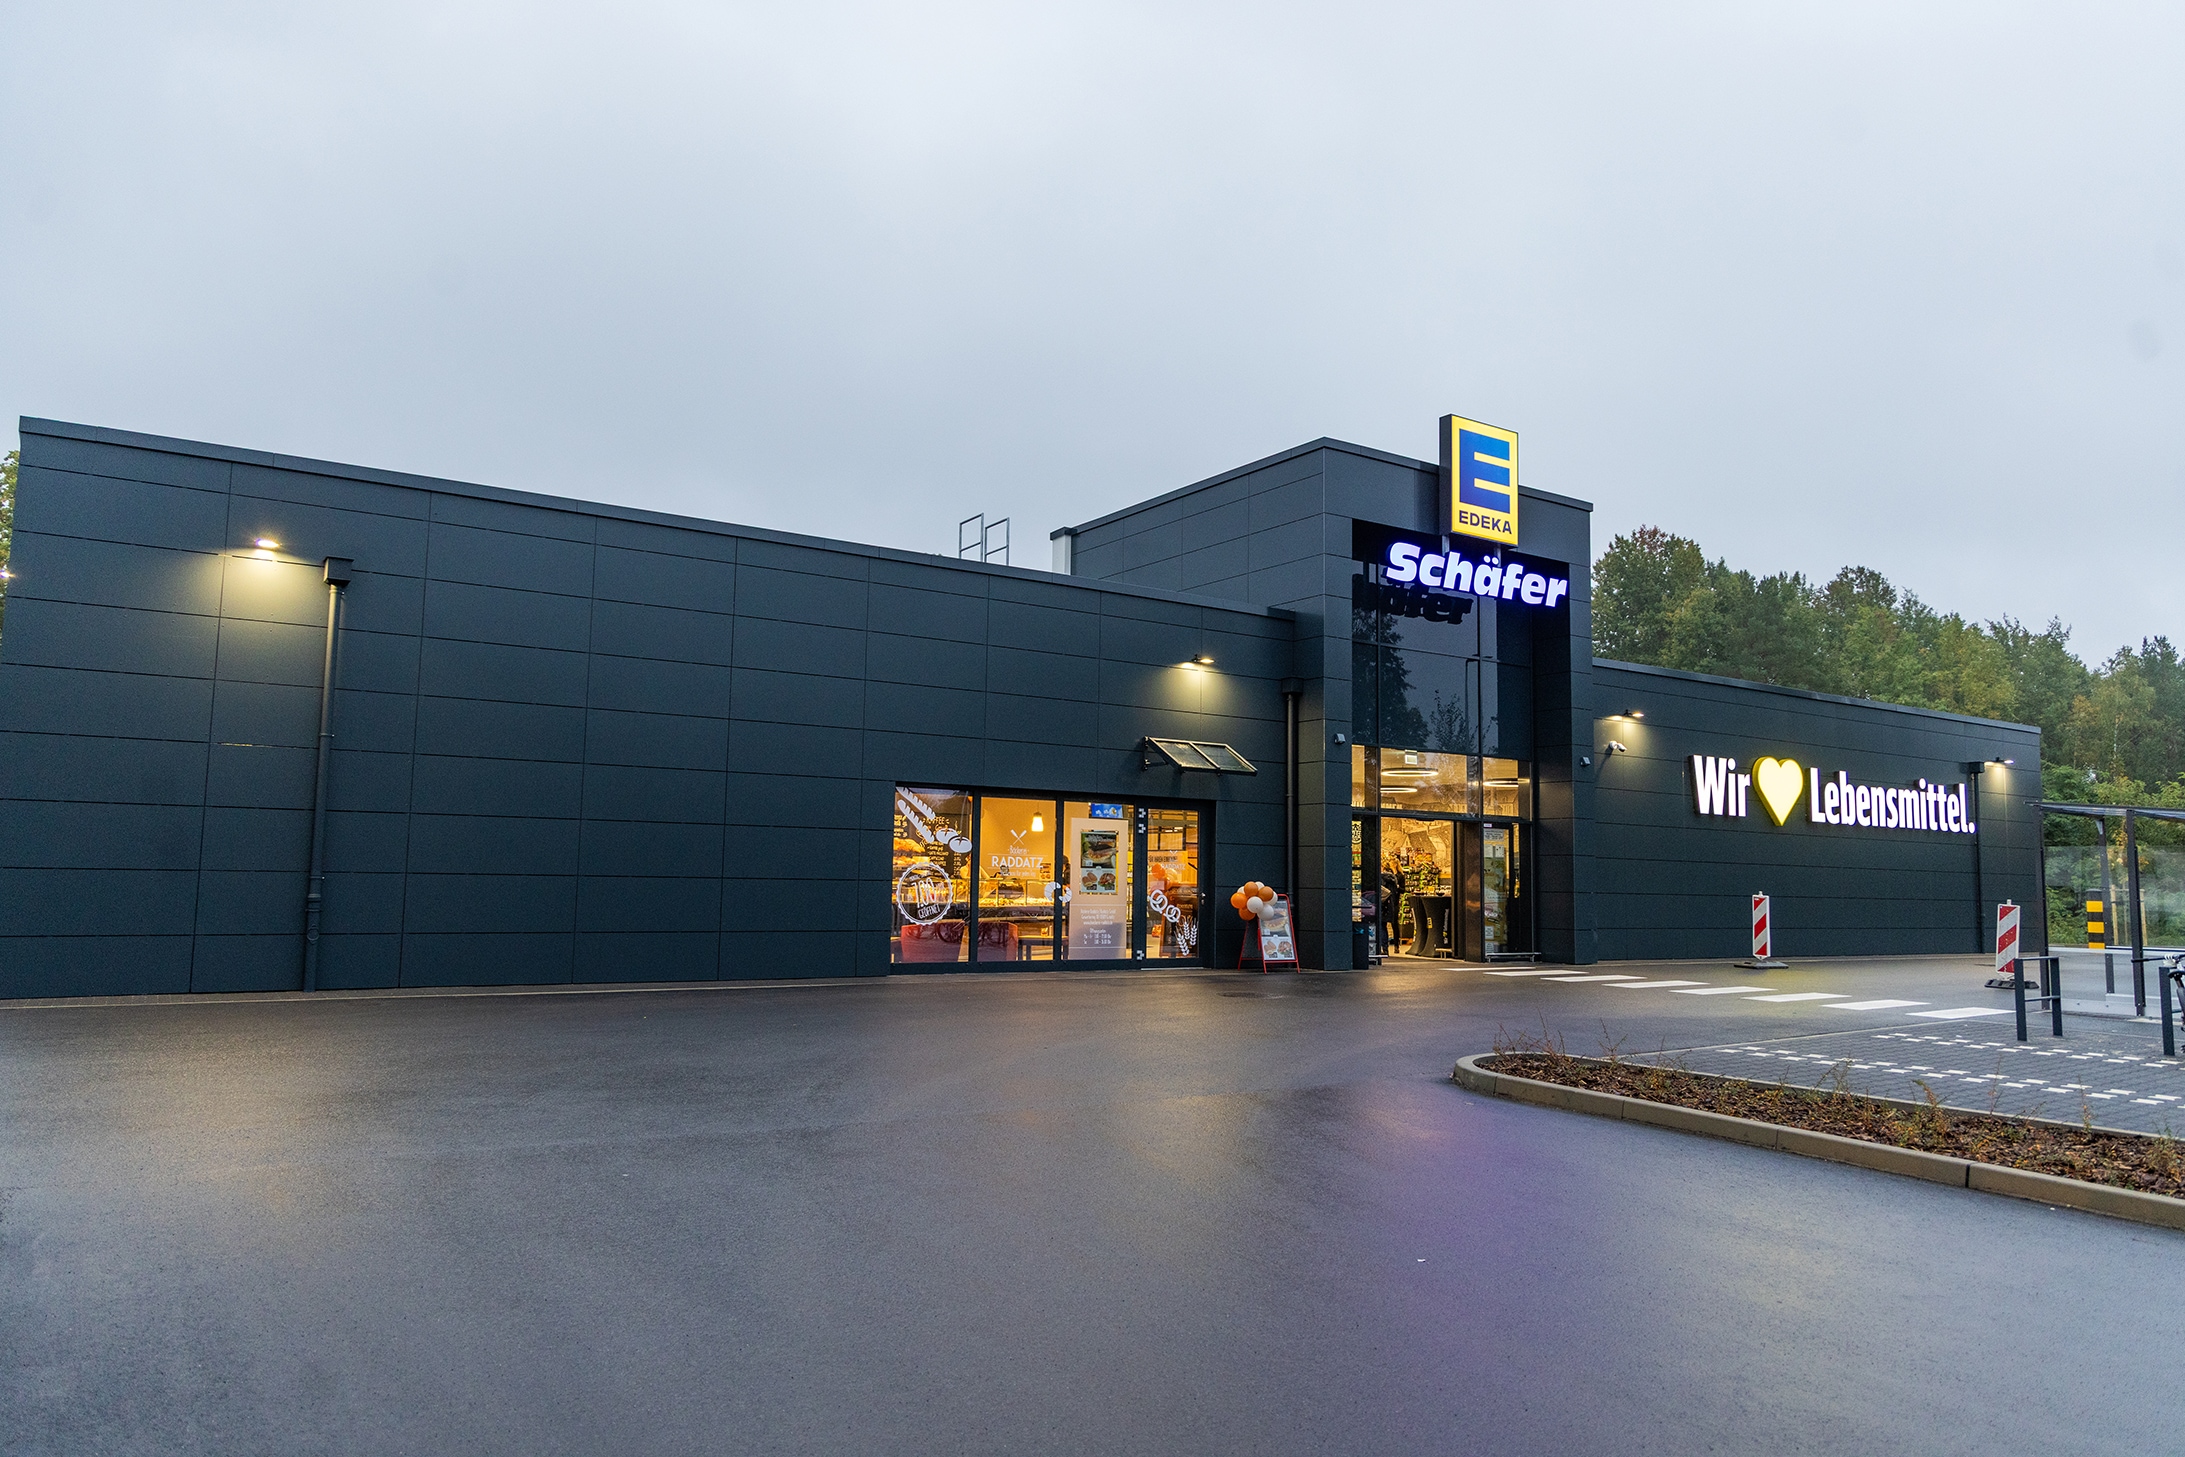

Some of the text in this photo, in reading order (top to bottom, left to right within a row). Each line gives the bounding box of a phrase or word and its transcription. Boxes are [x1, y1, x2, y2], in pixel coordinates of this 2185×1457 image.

[1459, 509, 1512, 534] EDEKA
[1386, 542, 1568, 607] Schäfer
[1692, 754, 1977, 834] Wir Lebensmittel.
[991, 855, 1044, 868] RADDATZ
[911, 877, 936, 908] 7.00
